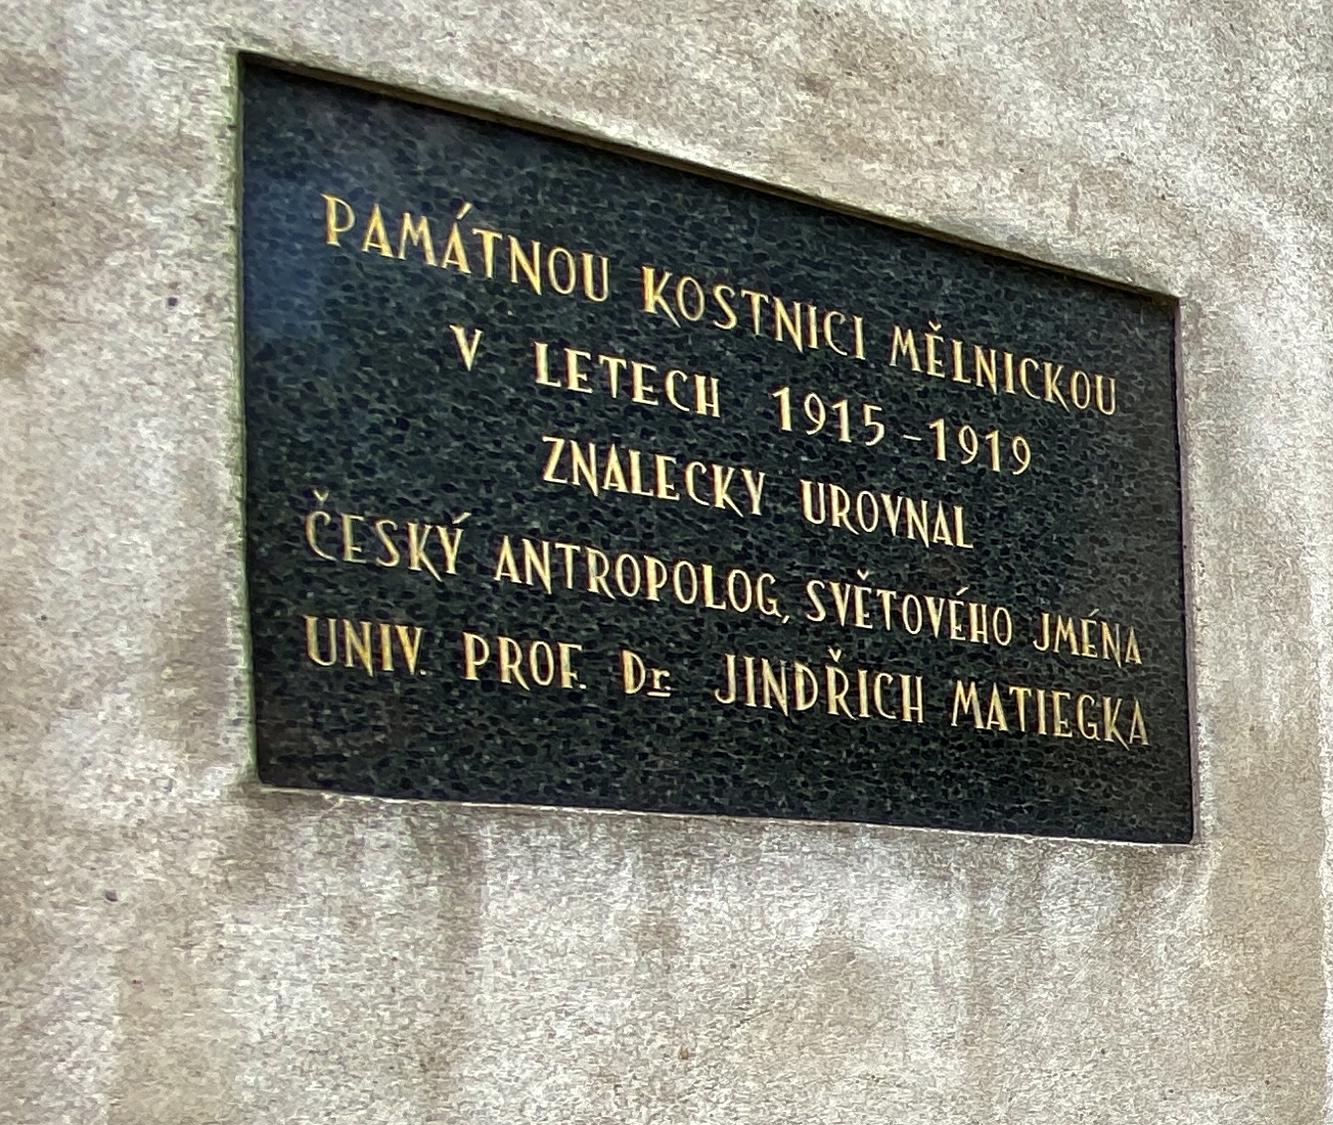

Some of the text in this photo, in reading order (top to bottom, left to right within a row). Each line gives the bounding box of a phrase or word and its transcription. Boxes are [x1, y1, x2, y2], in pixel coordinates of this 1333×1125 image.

[324, 194, 1118, 416] PAMÁTNOU KOSTNICI MĚLNICKOU
[449, 324, 484, 371] V
[534, 342, 721, 418] LETECH
[542, 437, 974, 550] ZNALECKY UROVNAL
[306, 489, 1144, 667] ČESKÝ ANTROPOLOG, SVĚTOVÉHO JMÉNA
[305, 615, 428, 678] UNIV.
[464, 630, 587, 691] PROF.
[713, 647, 925, 726] JINDŘICH
[950, 682, 1151, 749] MATIEGKA
